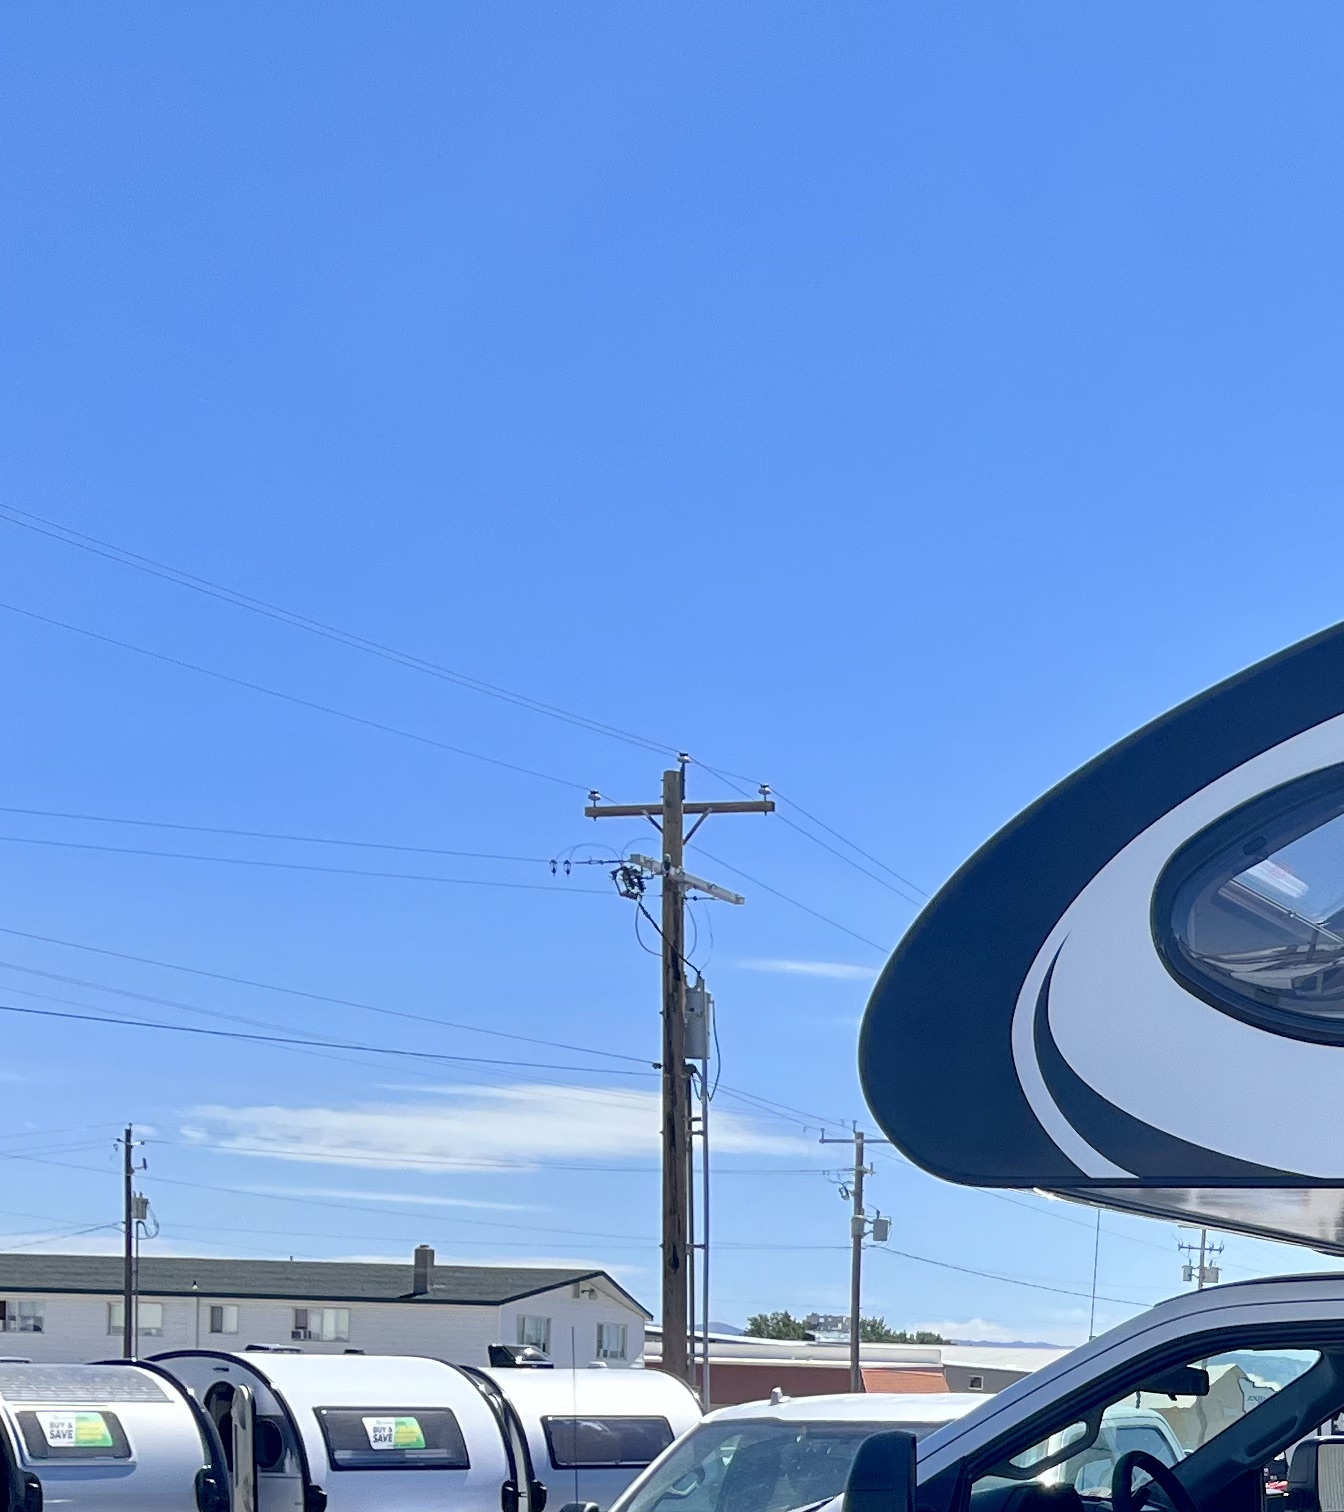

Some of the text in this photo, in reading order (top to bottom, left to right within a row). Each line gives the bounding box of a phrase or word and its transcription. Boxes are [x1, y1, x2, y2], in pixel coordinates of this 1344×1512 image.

[49, 1421, 66, 1429] BUY
[49, 1429, 73, 1440] SAVE
[373, 1433, 393, 1443] SAVE
